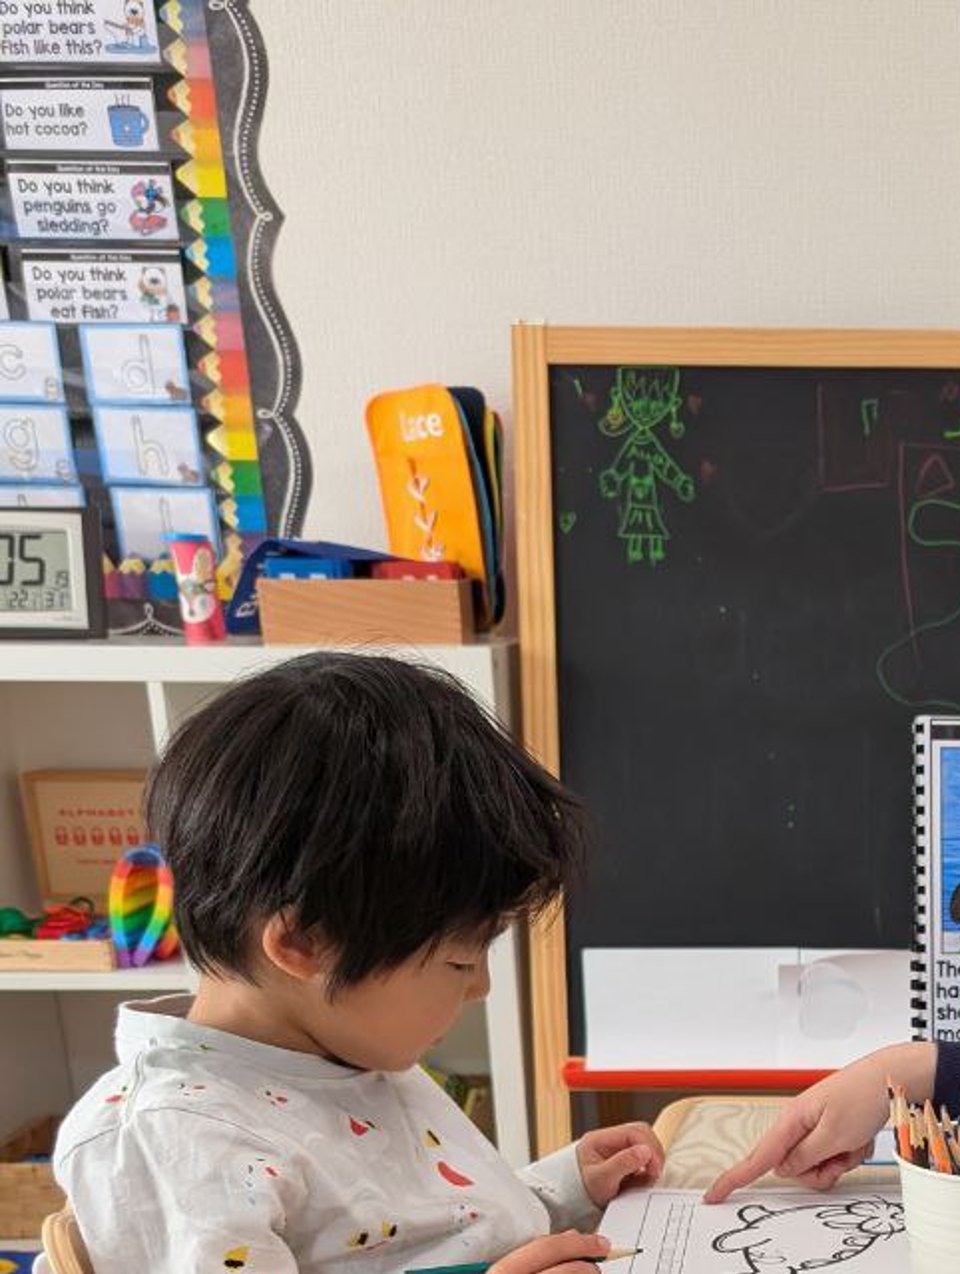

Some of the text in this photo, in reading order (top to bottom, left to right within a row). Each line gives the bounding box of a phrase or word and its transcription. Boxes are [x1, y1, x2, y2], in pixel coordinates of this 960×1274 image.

[0, 0, 95, 18] Do you think
[3, 20, 96, 37] polar bears
[34, 40, 60, 54] like
[66, 40, 102, 54] this?
[5, 103, 84, 120] Do you like
[6, 122, 88, 135] hot cocoa?
[18, 179, 115, 196] Do you think
[24, 201, 116, 216] penguins go
[38, 218, 109, 235] sledding?
[32, 266, 126, 283] Do you think
[37, 287, 128, 302] polar bears
[50, 304, 76, 318] eat
